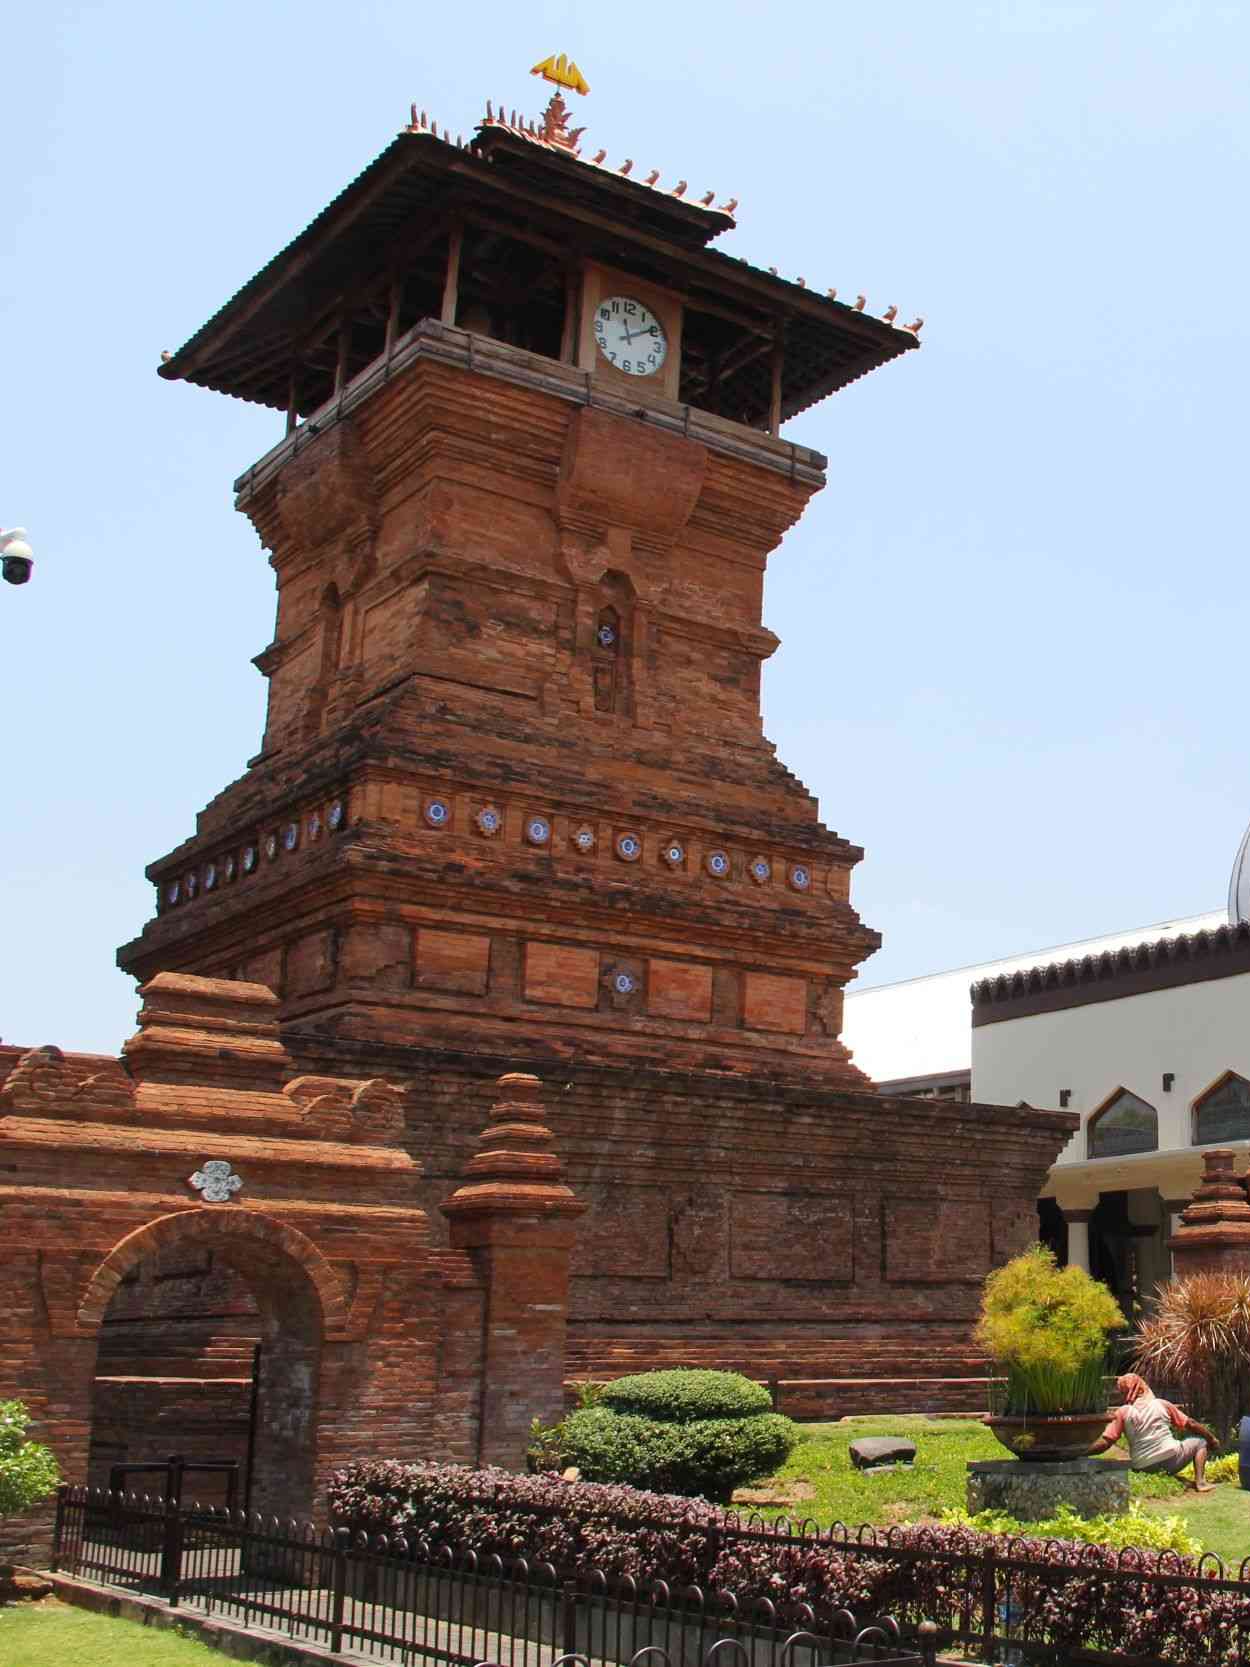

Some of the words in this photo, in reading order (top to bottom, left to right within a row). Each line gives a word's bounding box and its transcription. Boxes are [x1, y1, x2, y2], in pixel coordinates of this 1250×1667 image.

[612, 301, 619, 314] 11
[624, 301, 636, 316] 12
[594, 320, 603, 333] 9
[599, 337, 607, 349] 8
[654, 341, 661, 353] 3
[609, 351, 616, 361] 7
[648, 353, 656, 366] 4
[623, 360, 631, 372] 6
[637, 361, 647, 373] 5
